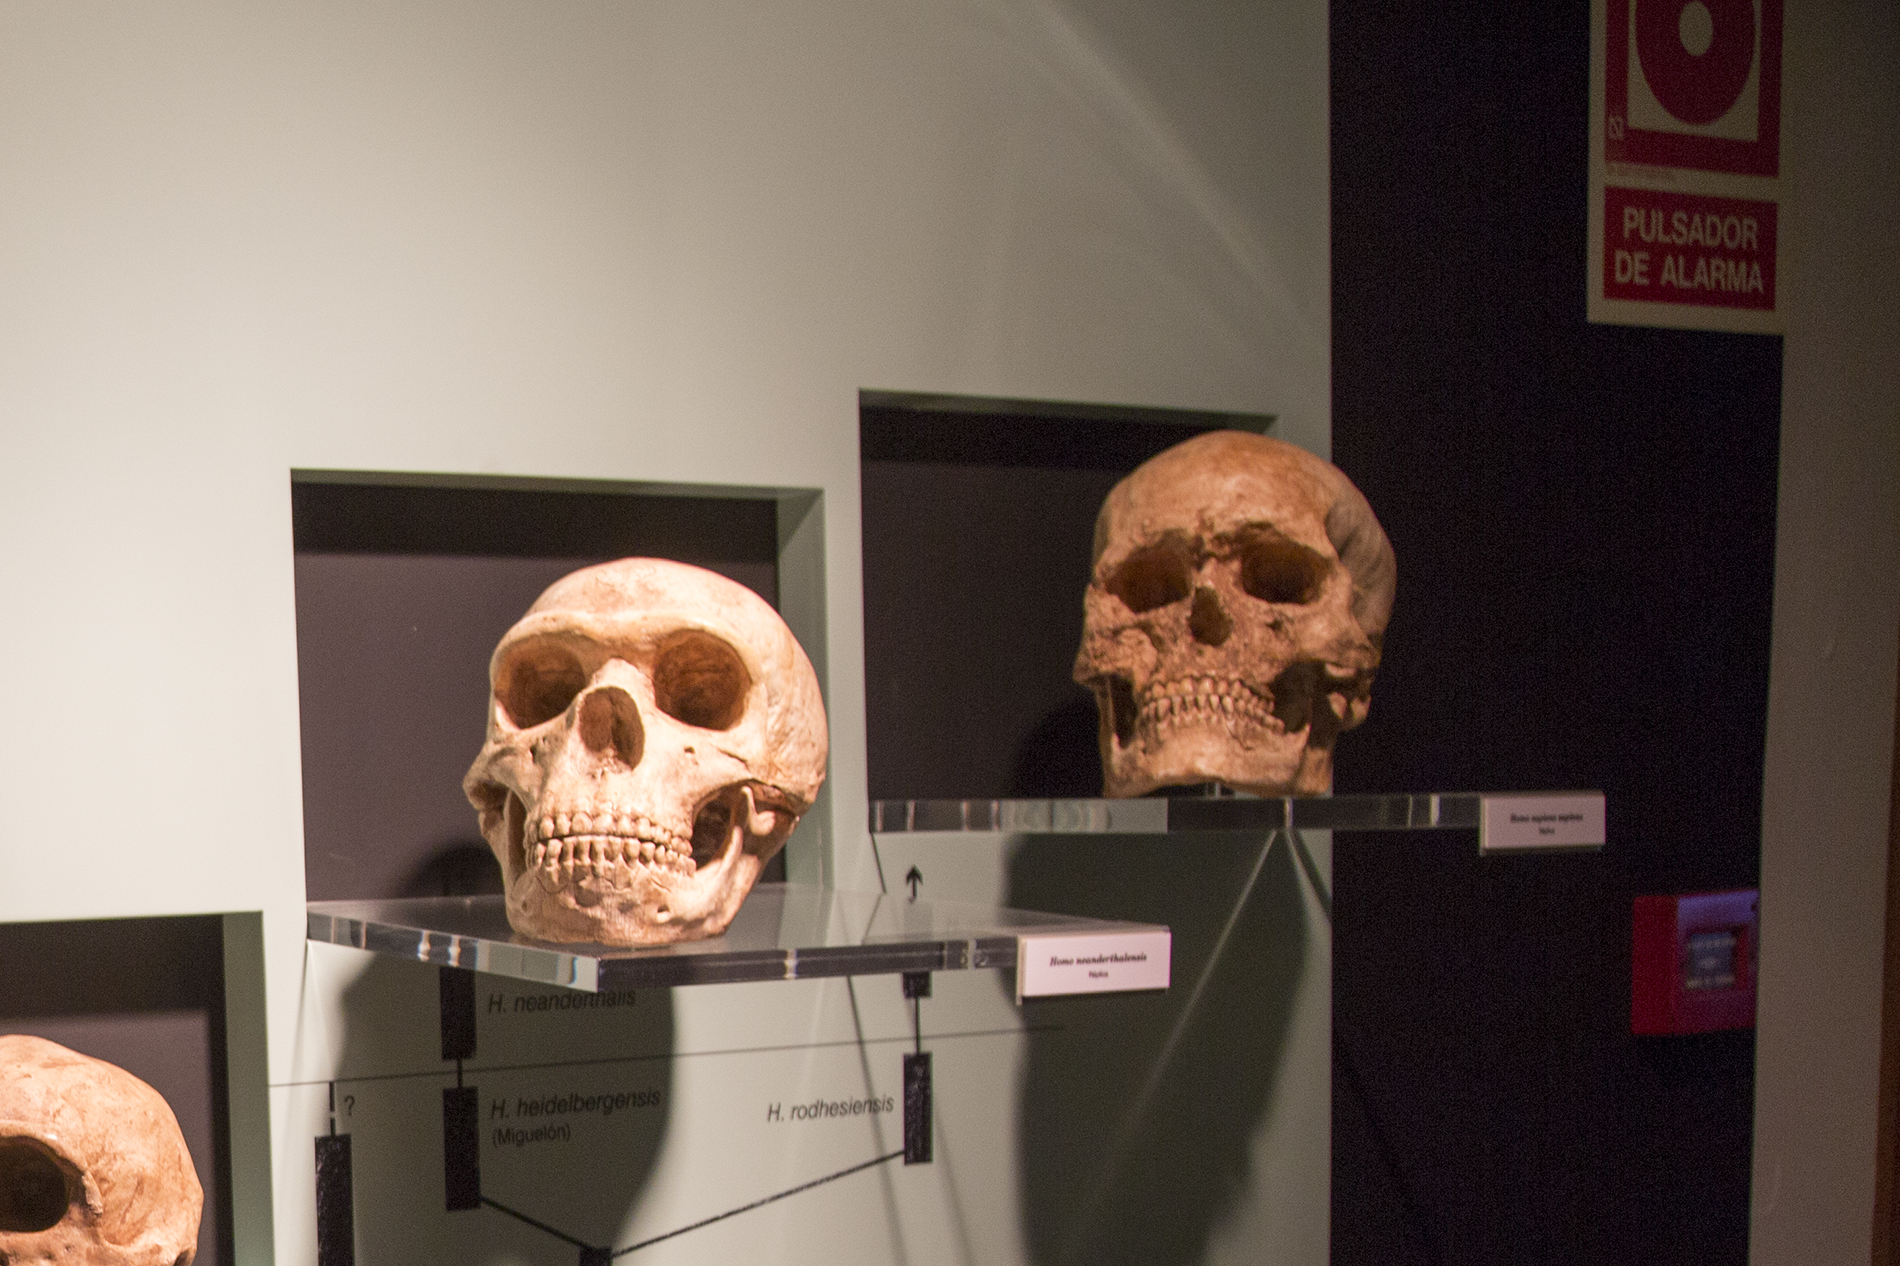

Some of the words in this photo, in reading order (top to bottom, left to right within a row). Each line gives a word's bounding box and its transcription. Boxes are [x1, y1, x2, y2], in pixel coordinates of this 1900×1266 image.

[1623, 206, 1759, 250] PULSADOR
[1615, 251, 1650, 286] DE
[1662, 254, 1764, 294] ALARMA
[1050, 956, 1074, 966] Homo
[488, 994, 506, 1014] H.
[344, 1095, 355, 1116] ?
[491, 1099, 511, 1120] H.
[516, 1087, 661, 1119] heidelbergensis
[767, 1102, 785, 1123] H.
[790, 1094, 894, 1120] rodhesiensis
[492, 1125, 571, 1148] (Miguelón)
